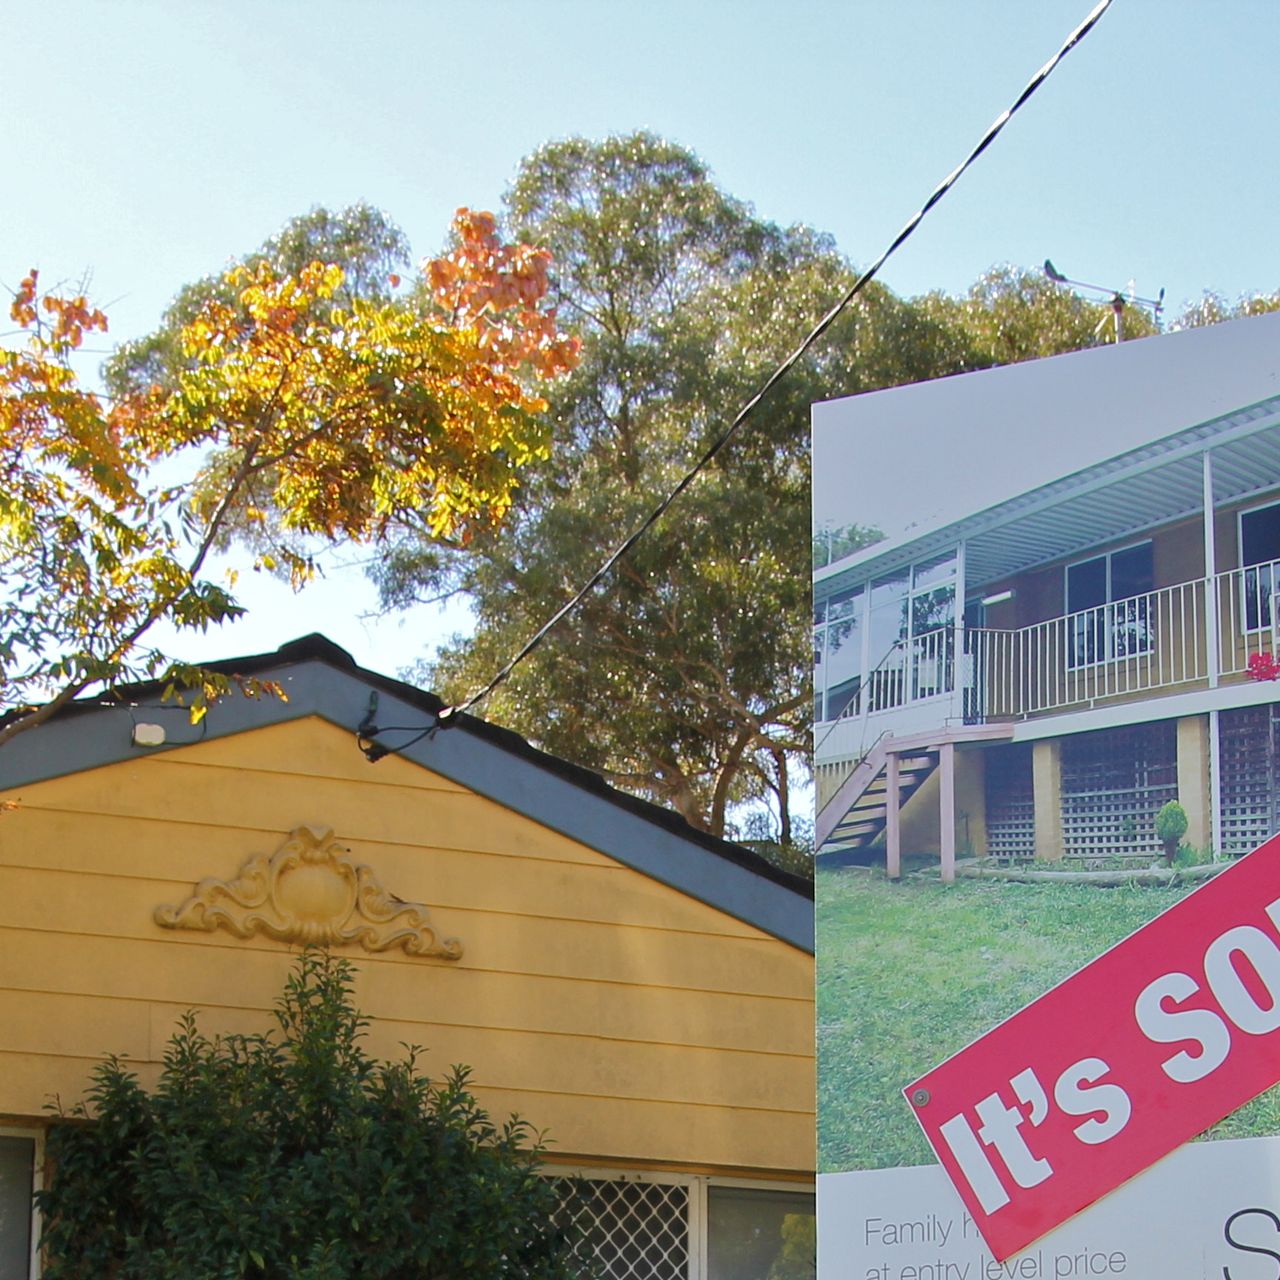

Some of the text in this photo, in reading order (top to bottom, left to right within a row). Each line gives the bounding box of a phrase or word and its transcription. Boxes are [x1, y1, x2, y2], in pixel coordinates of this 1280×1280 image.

[939, 1056, 1131, 1216] It's
[865, 1213, 953, 1247] Family
[980, 1250, 1043, 1280] level
